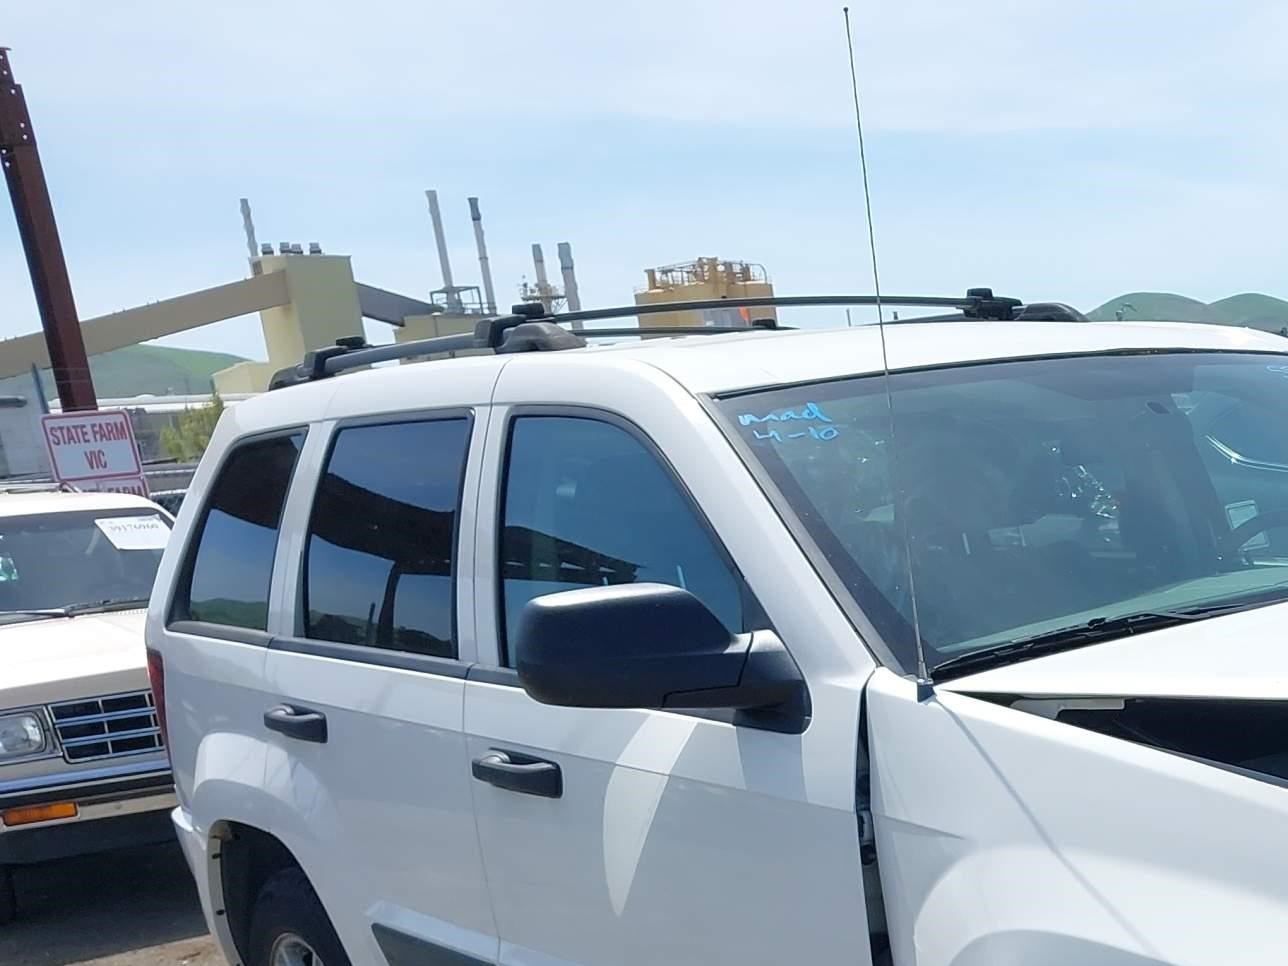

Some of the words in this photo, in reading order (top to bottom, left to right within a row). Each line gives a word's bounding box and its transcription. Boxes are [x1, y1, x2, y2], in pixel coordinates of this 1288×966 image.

[49, 424, 91, 446] STATE
[91, 421, 128, 442] FARM
[84, 449, 108, 470] VIC
